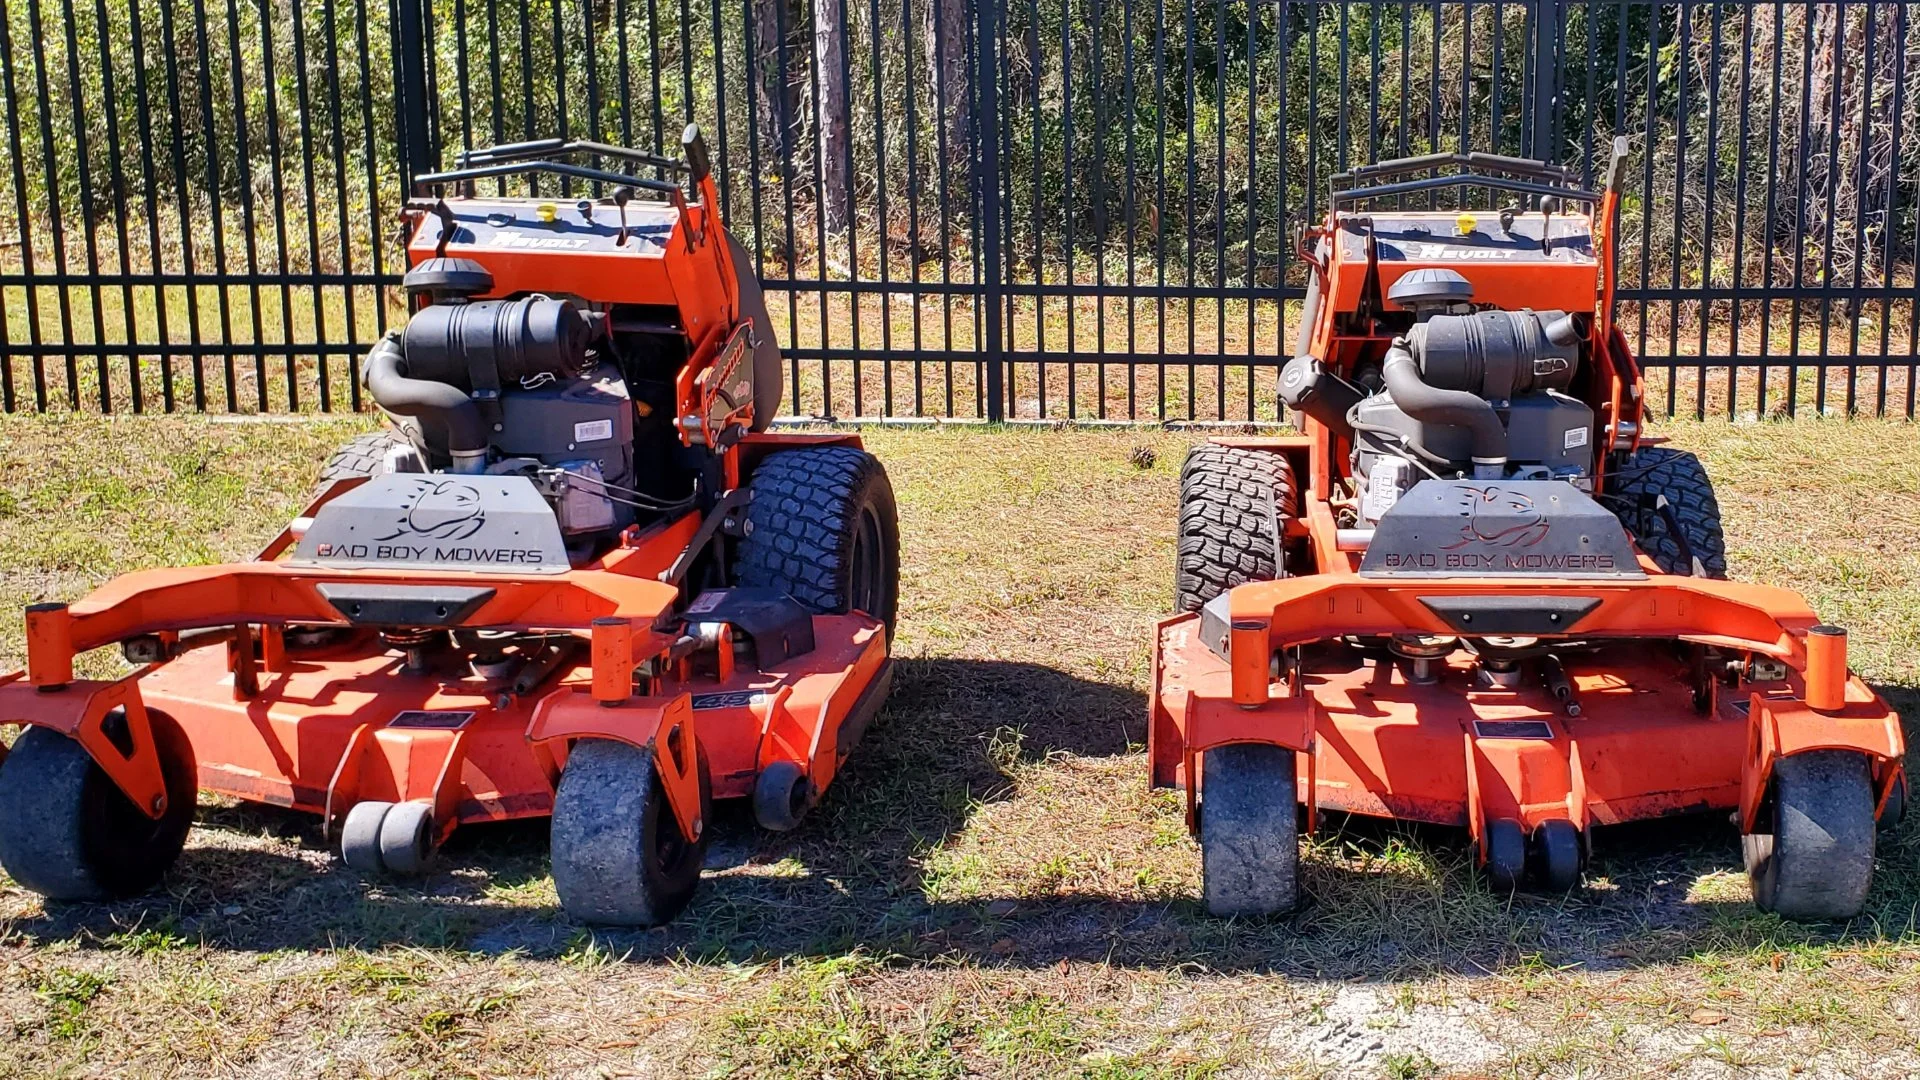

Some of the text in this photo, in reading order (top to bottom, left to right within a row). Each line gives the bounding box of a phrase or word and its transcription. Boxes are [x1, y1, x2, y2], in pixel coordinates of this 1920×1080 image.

[489, 231, 590, 249] REVOLT
[1419, 244, 1517, 260] REVOLT
[317, 544, 543, 563] BAD BOY MOWERS
[1386, 553, 1615, 569] BAD BOY MOWERS
